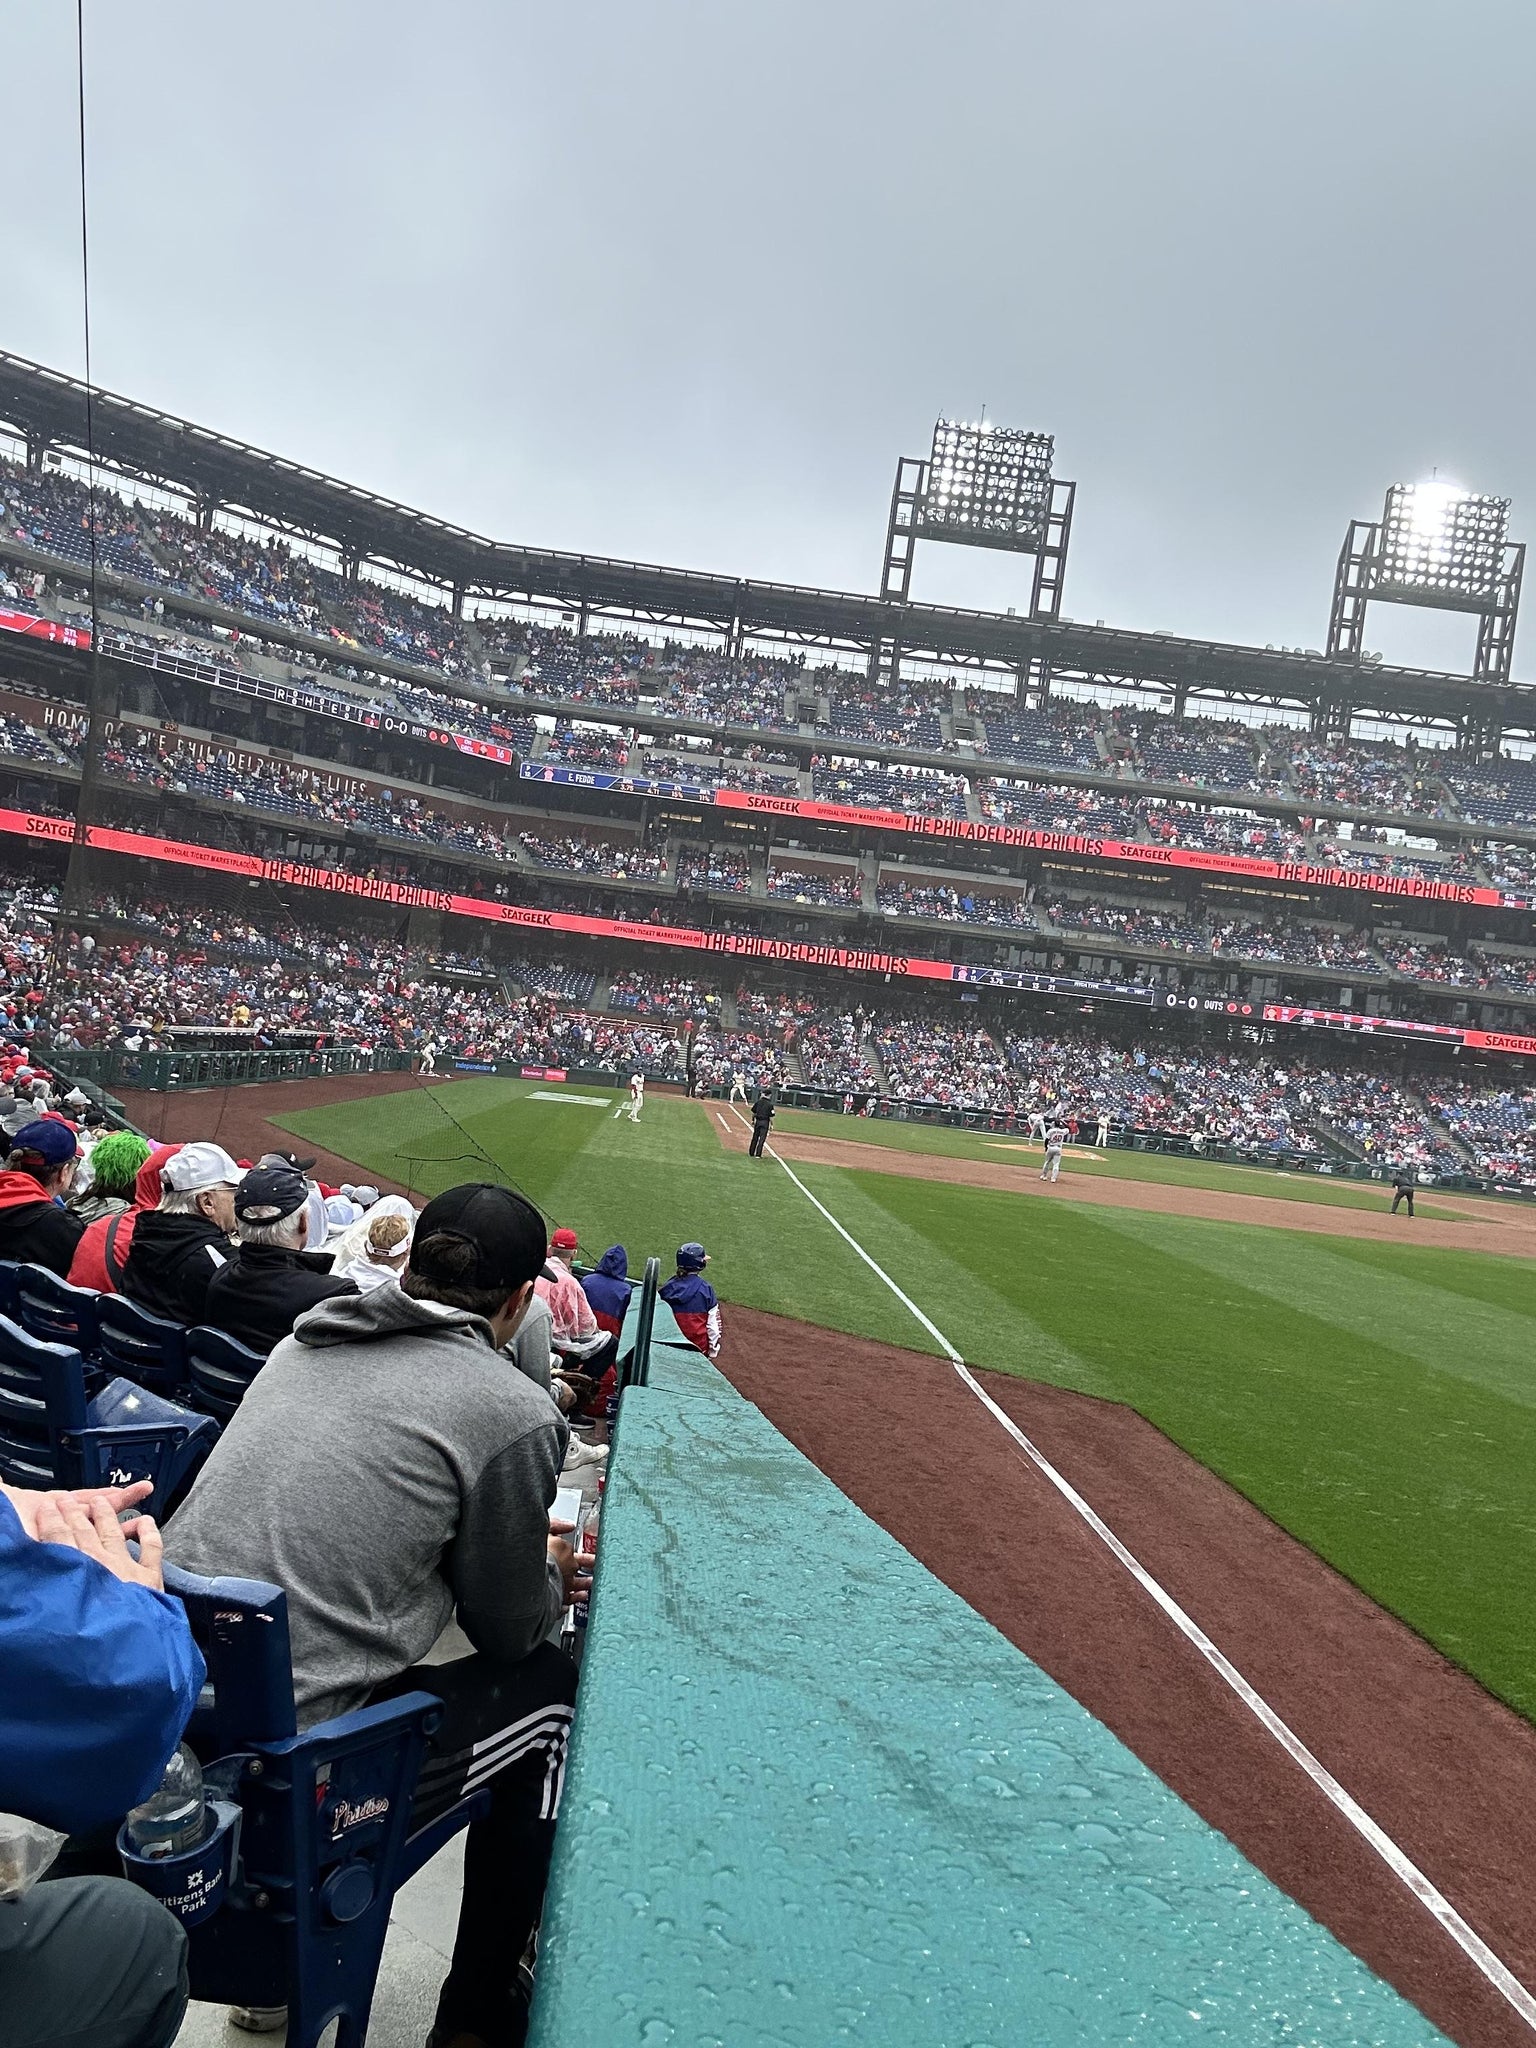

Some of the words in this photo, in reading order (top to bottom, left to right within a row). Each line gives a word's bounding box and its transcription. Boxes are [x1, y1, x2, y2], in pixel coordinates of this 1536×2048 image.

[278, 688, 286, 700] R
[305, 696, 313, 707] H
[331, 703, 338, 714] E
[411, 725, 428, 738] OUTS
[496, 748, 505, 759] 16
[576, 774, 595, 785] FEDDE
[747, 795, 800, 814] SEATGEEK
[905, 814, 930, 834] THE
[934, 817, 1037, 846] PHILADELPHIA
[1042, 831, 1104, 855] PHILLIES
[26, 817, 93, 844] SEATGEK
[260, 858, 288, 881] THE
[291, 864, 393, 901] PHILADELPHIA
[396, 884, 453, 911] PHILLIES
[1120, 845, 1172, 862] SEATGEEK
[1189, 856, 1212, 865] OFFICIAL
[1276, 863, 1302, 882] THE
[1306, 866, 1409, 895] PHILADELPHIA
[1413, 879, 1476, 903] PHILLIES
[501, 907, 552, 926] SEATGEEK
[704, 932, 732, 951] THE
[735, 936, 840, 966] PHILADELPHIA
[845, 951, 909, 975] PHILLIES
[1047, 984, 1056, 992] 21
[1204, 1000, 1224, 1012] OUTS
[1485, 1034, 1536, 1051] SEATGEEK
[332, 1797, 389, 1833] Phillies
[181, 1897, 207, 1914] Park
